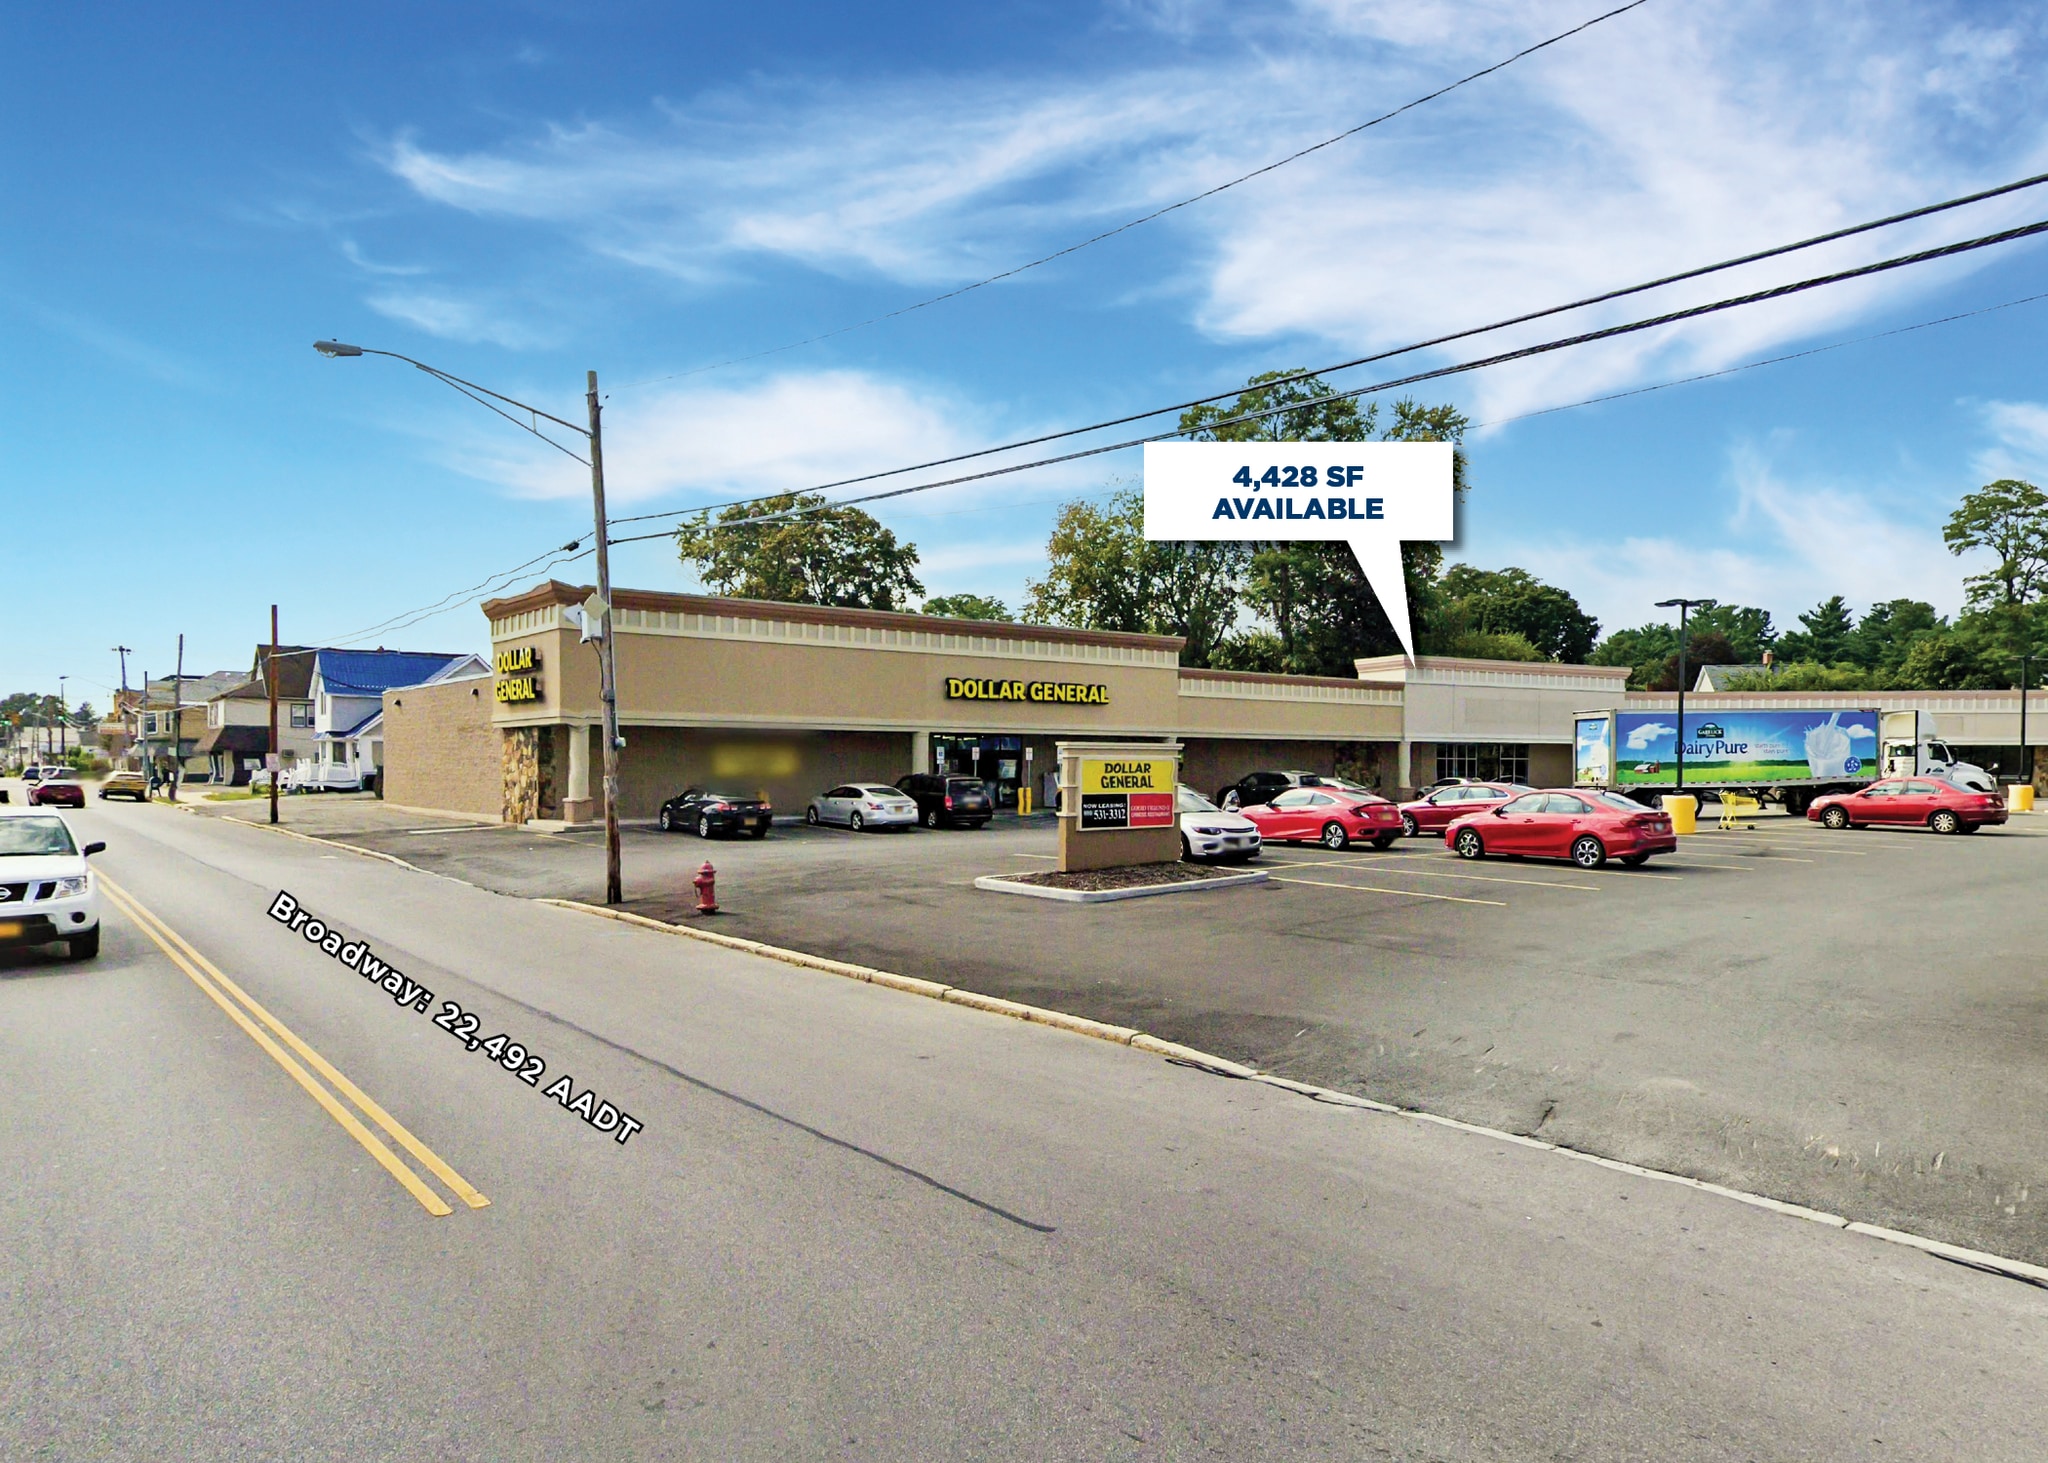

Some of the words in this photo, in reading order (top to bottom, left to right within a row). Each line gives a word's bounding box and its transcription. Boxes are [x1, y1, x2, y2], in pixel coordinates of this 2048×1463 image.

[497, 647, 533, 673] DOLLAR
[495, 677, 536, 702] GENERAL
[947, 679, 1026, 700] DOLLAR
[1030, 682, 1110, 704] GENERAL
[1104, 763, 1151, 774] DOLLAR
[1101, 776, 1154, 788] GENERAL
[1093, 809, 1126, 820] 531-3312
